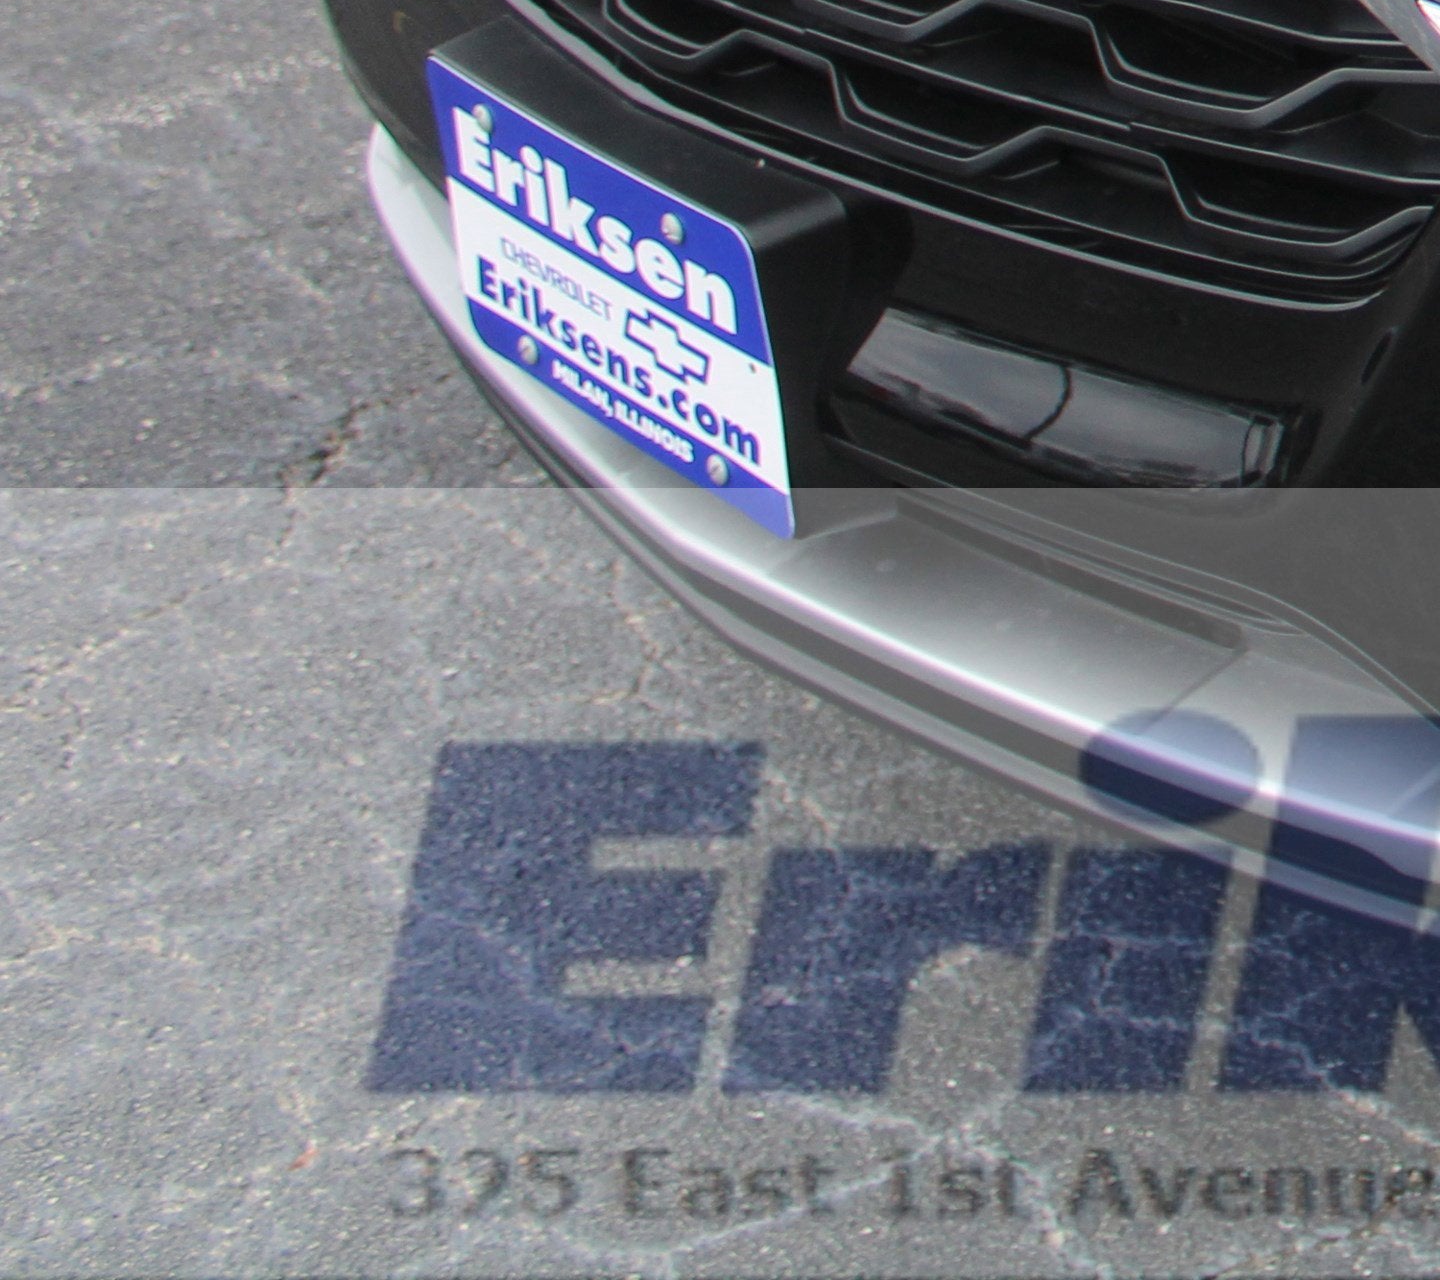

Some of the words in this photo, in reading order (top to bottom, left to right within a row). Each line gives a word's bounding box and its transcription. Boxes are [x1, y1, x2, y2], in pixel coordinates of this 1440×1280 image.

[453, 106, 737, 336] Eriksen
[501, 238, 612, 321] CHEVROLET
[478, 255, 760, 467] Eriksens.com
